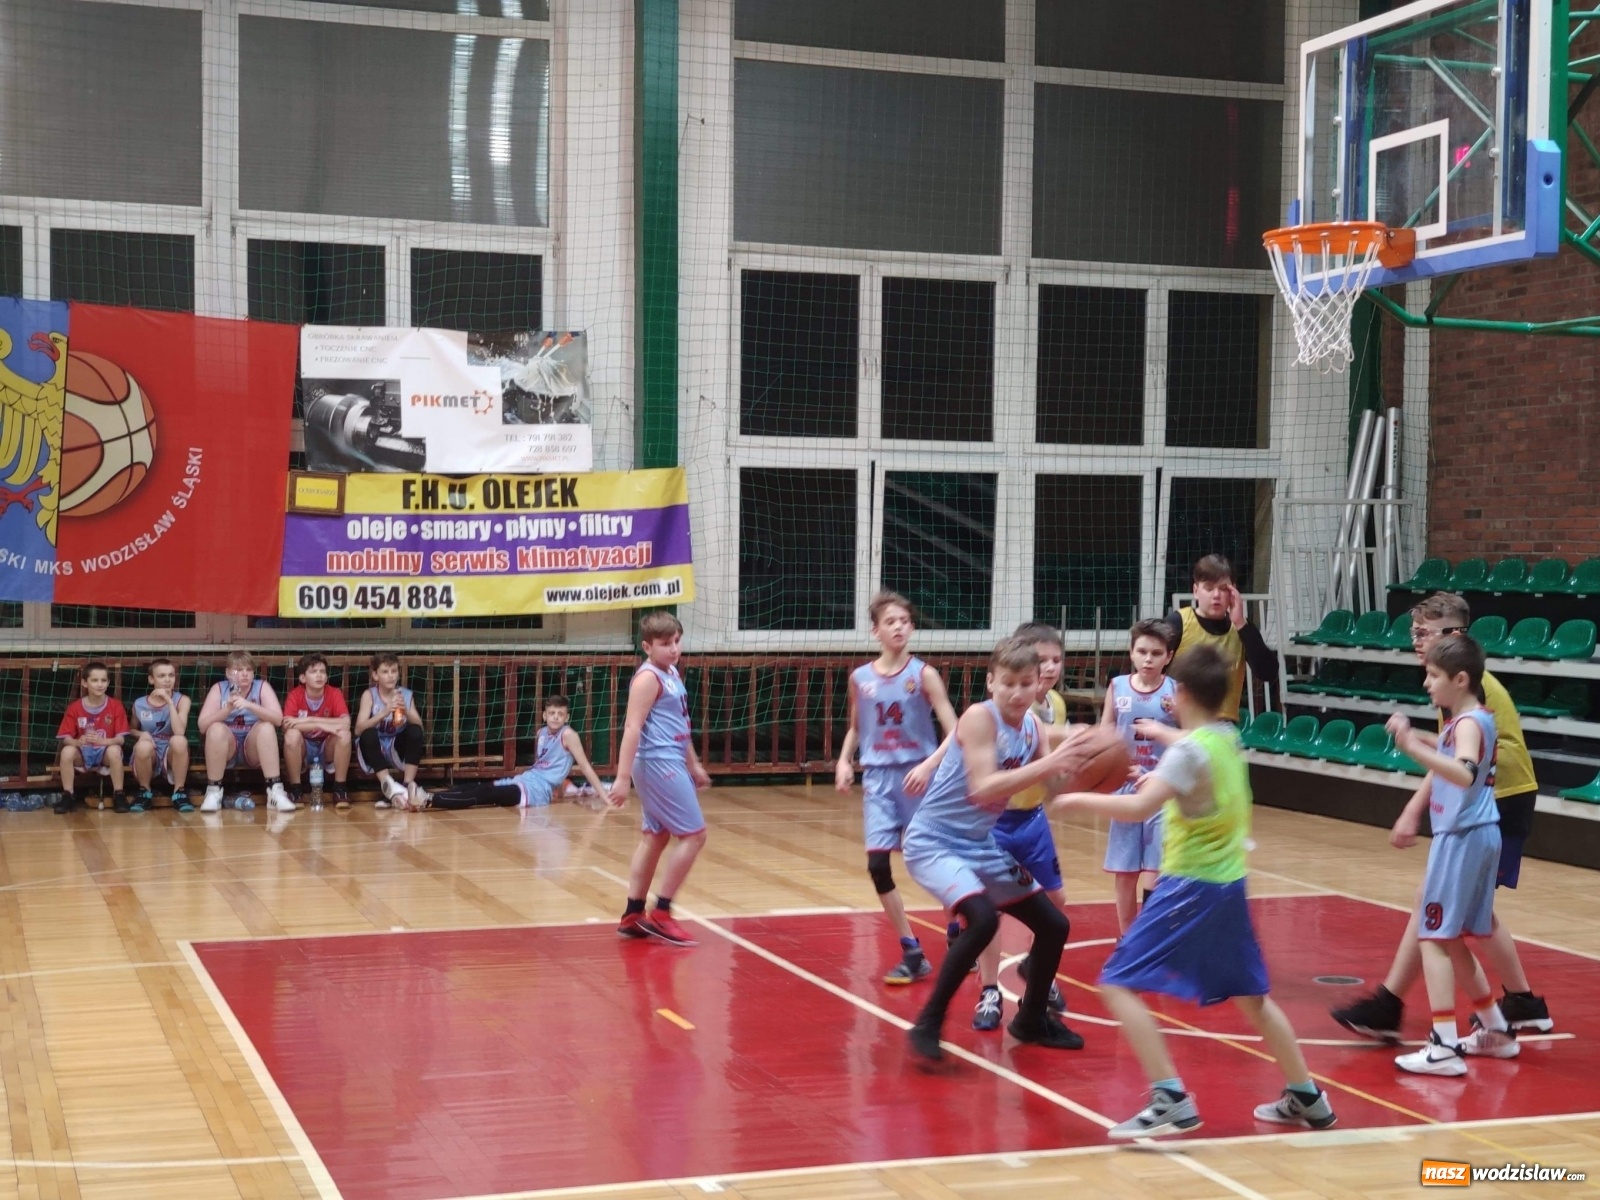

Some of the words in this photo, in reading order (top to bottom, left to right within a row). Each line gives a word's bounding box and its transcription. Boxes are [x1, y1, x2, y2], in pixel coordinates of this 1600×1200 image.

[319, 344, 358, 352] TOCZENIE
[410, 394, 481, 408] PIKMET
[482, 477, 579, 510] OLEJEK
[34, 559, 73, 575] MKS
[80, 509, 176, 574] WODZISŁAW
[171, 447, 203, 509] ŚLĄSKI
[326, 547, 424, 575] mobilny
[430, 546, 510, 573] serwis
[517, 541, 652, 571] klimatyzacji
[298, 585, 348, 610] 609
[354, 585, 401, 610] 454
[407, 585, 454, 610] 884
[875, 701, 904, 726] 14
[1425, 902, 1443, 931] 9
